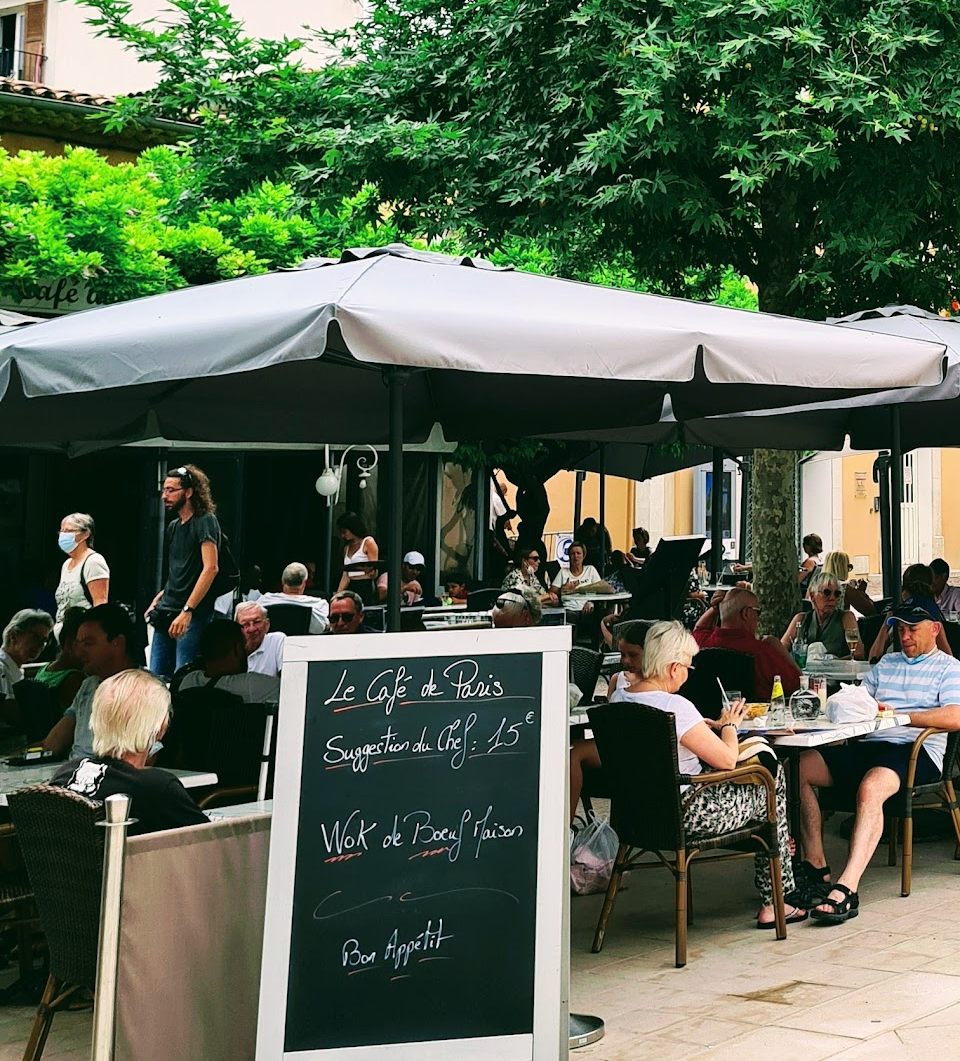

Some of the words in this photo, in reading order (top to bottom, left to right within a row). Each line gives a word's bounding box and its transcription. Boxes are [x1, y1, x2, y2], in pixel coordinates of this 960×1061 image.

[324, 669, 356, 705] Le
[366, 666, 412, 715] Café
[421, 668, 444, 698] de
[443, 659, 504, 699] Paris
[323, 725, 409, 773] Suggestion
[412, 726, 433, 753] du
[382, 815, 403, 848] de
[473, 805, 523, 859] Maison
[342, 938, 376, 967] Bon
